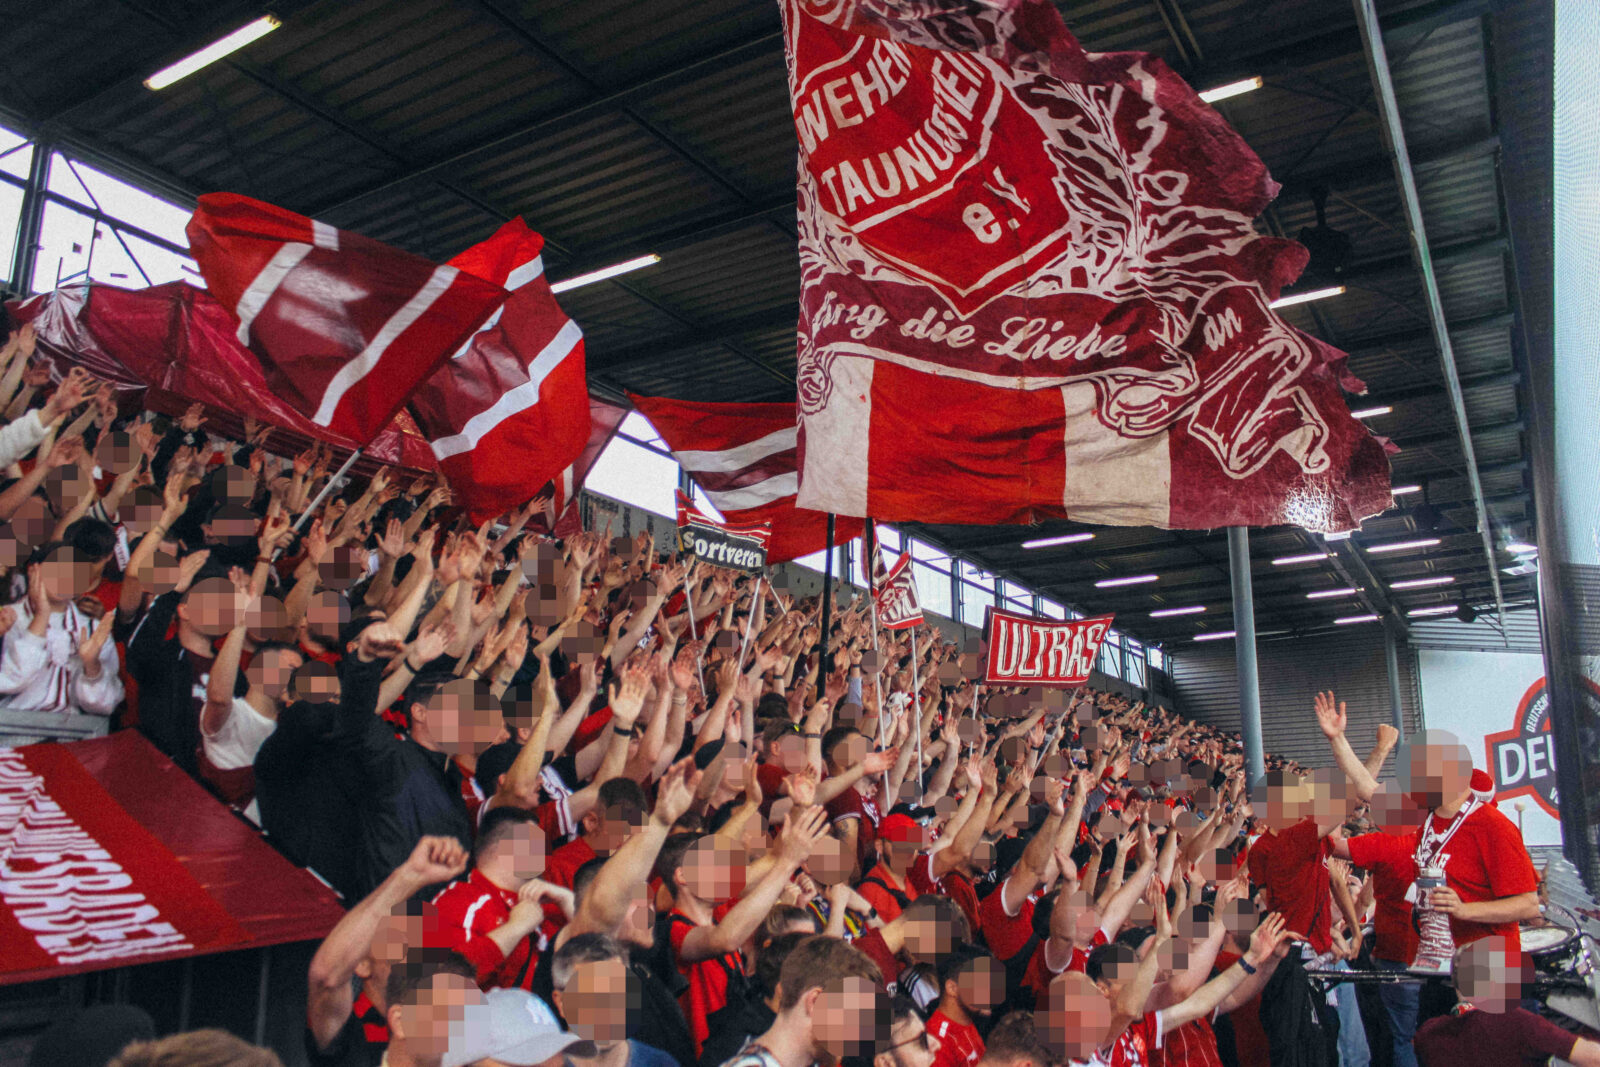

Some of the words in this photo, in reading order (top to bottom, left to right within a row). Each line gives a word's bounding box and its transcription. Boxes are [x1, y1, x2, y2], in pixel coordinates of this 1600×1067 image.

[796, 38, 912, 155] WEHEN
[900, 306, 976, 348] die
[983, 316, 1128, 361] Liebe
[1203, 307, 1242, 352] an
[997, 620, 1106, 678] ULTRAS
